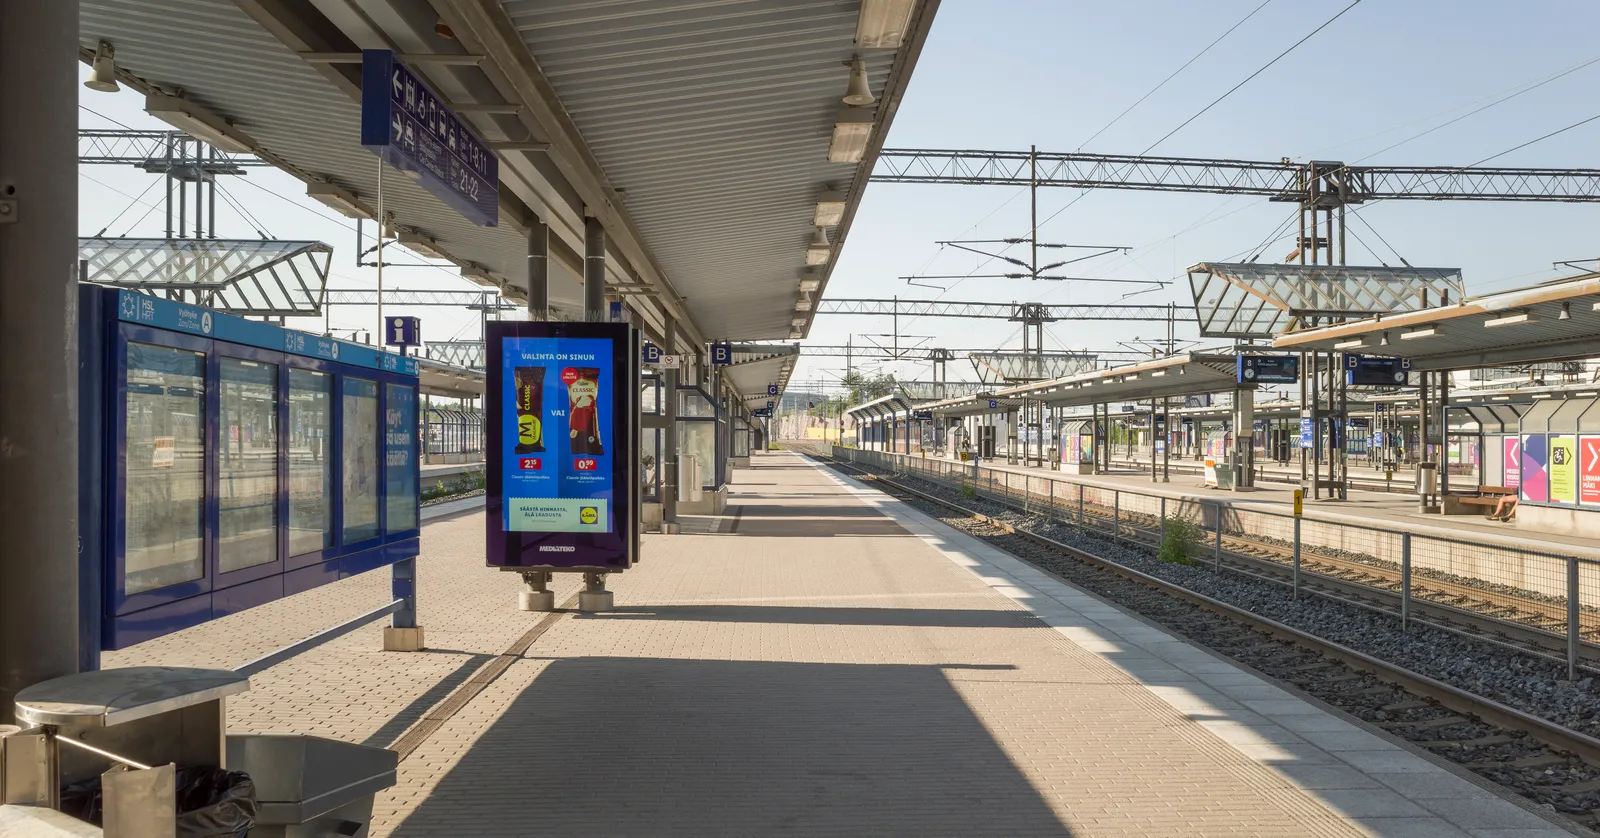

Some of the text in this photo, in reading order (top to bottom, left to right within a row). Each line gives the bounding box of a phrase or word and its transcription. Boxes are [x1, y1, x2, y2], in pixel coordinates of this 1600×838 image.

[460, 168, 479, 202] 21-22
[141, 299, 198, 320] HSL Vyöhyke
[141, 310, 154, 321] HRT
[203, 315, 210, 330] A
[648, 346, 659, 360] B
[716, 347, 727, 361] B
[1247, 359, 1252, 367] 8
[1348, 356, 1358, 368] B
[1401, 357, 1411, 369] B
[769, 386, 776, 394] C
[386, 407, 402, 429] Käyt
[519, 421, 532, 438] M
[394, 428, 411, 446] usein
[386, 450, 409, 467] täällä?
[524, 459, 537, 469] 2.15
[578, 460, 594, 469] 0.99
[1296, 495, 1300, 505] 1
